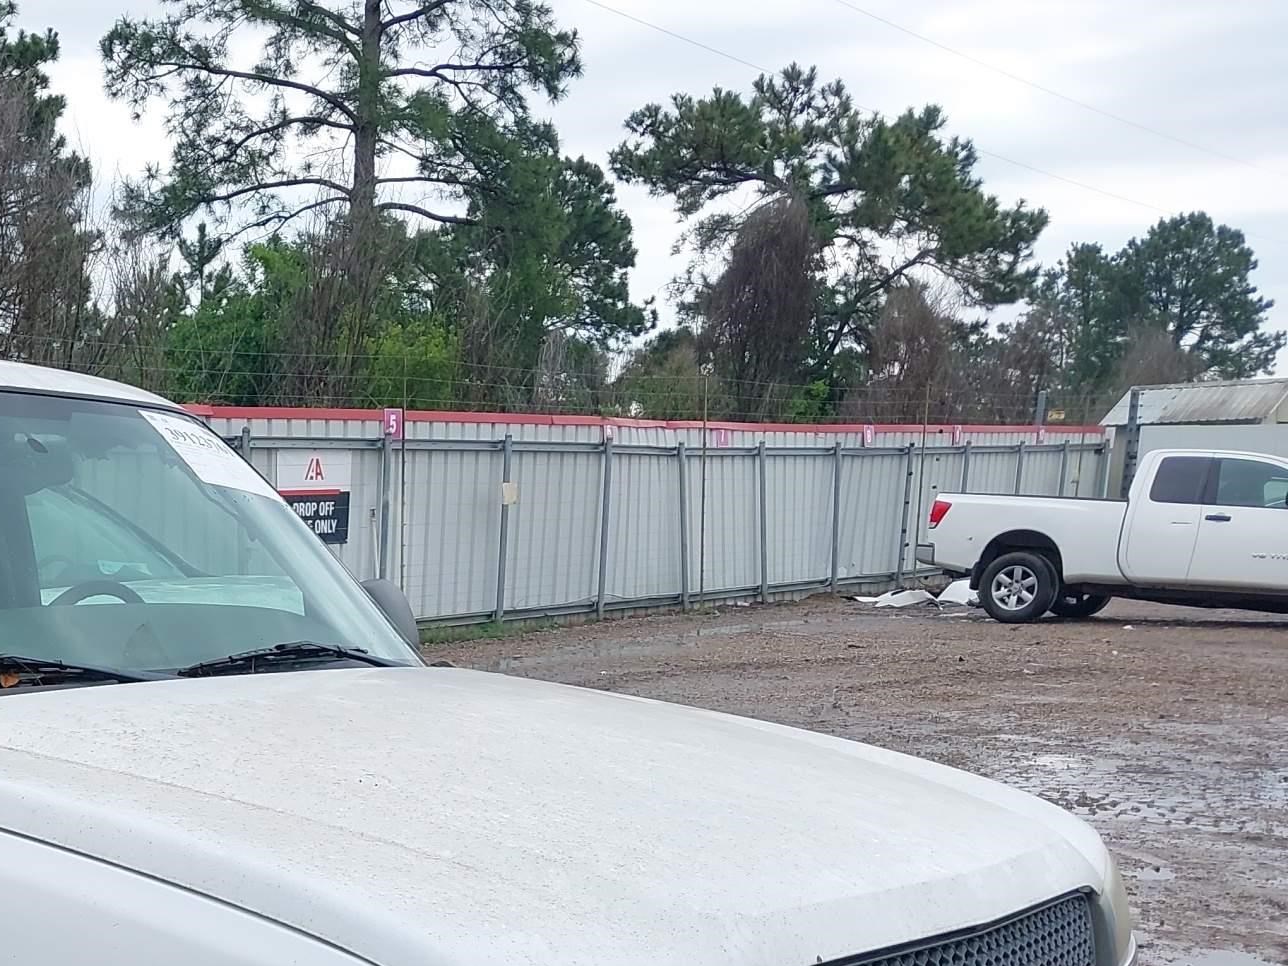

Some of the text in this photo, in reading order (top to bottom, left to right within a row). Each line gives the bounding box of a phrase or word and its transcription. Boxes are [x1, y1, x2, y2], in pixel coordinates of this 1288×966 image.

[388, 414, 397, 434] 5
[319, 501, 335, 516] OFF
[314, 519, 337, 534] ONLY
